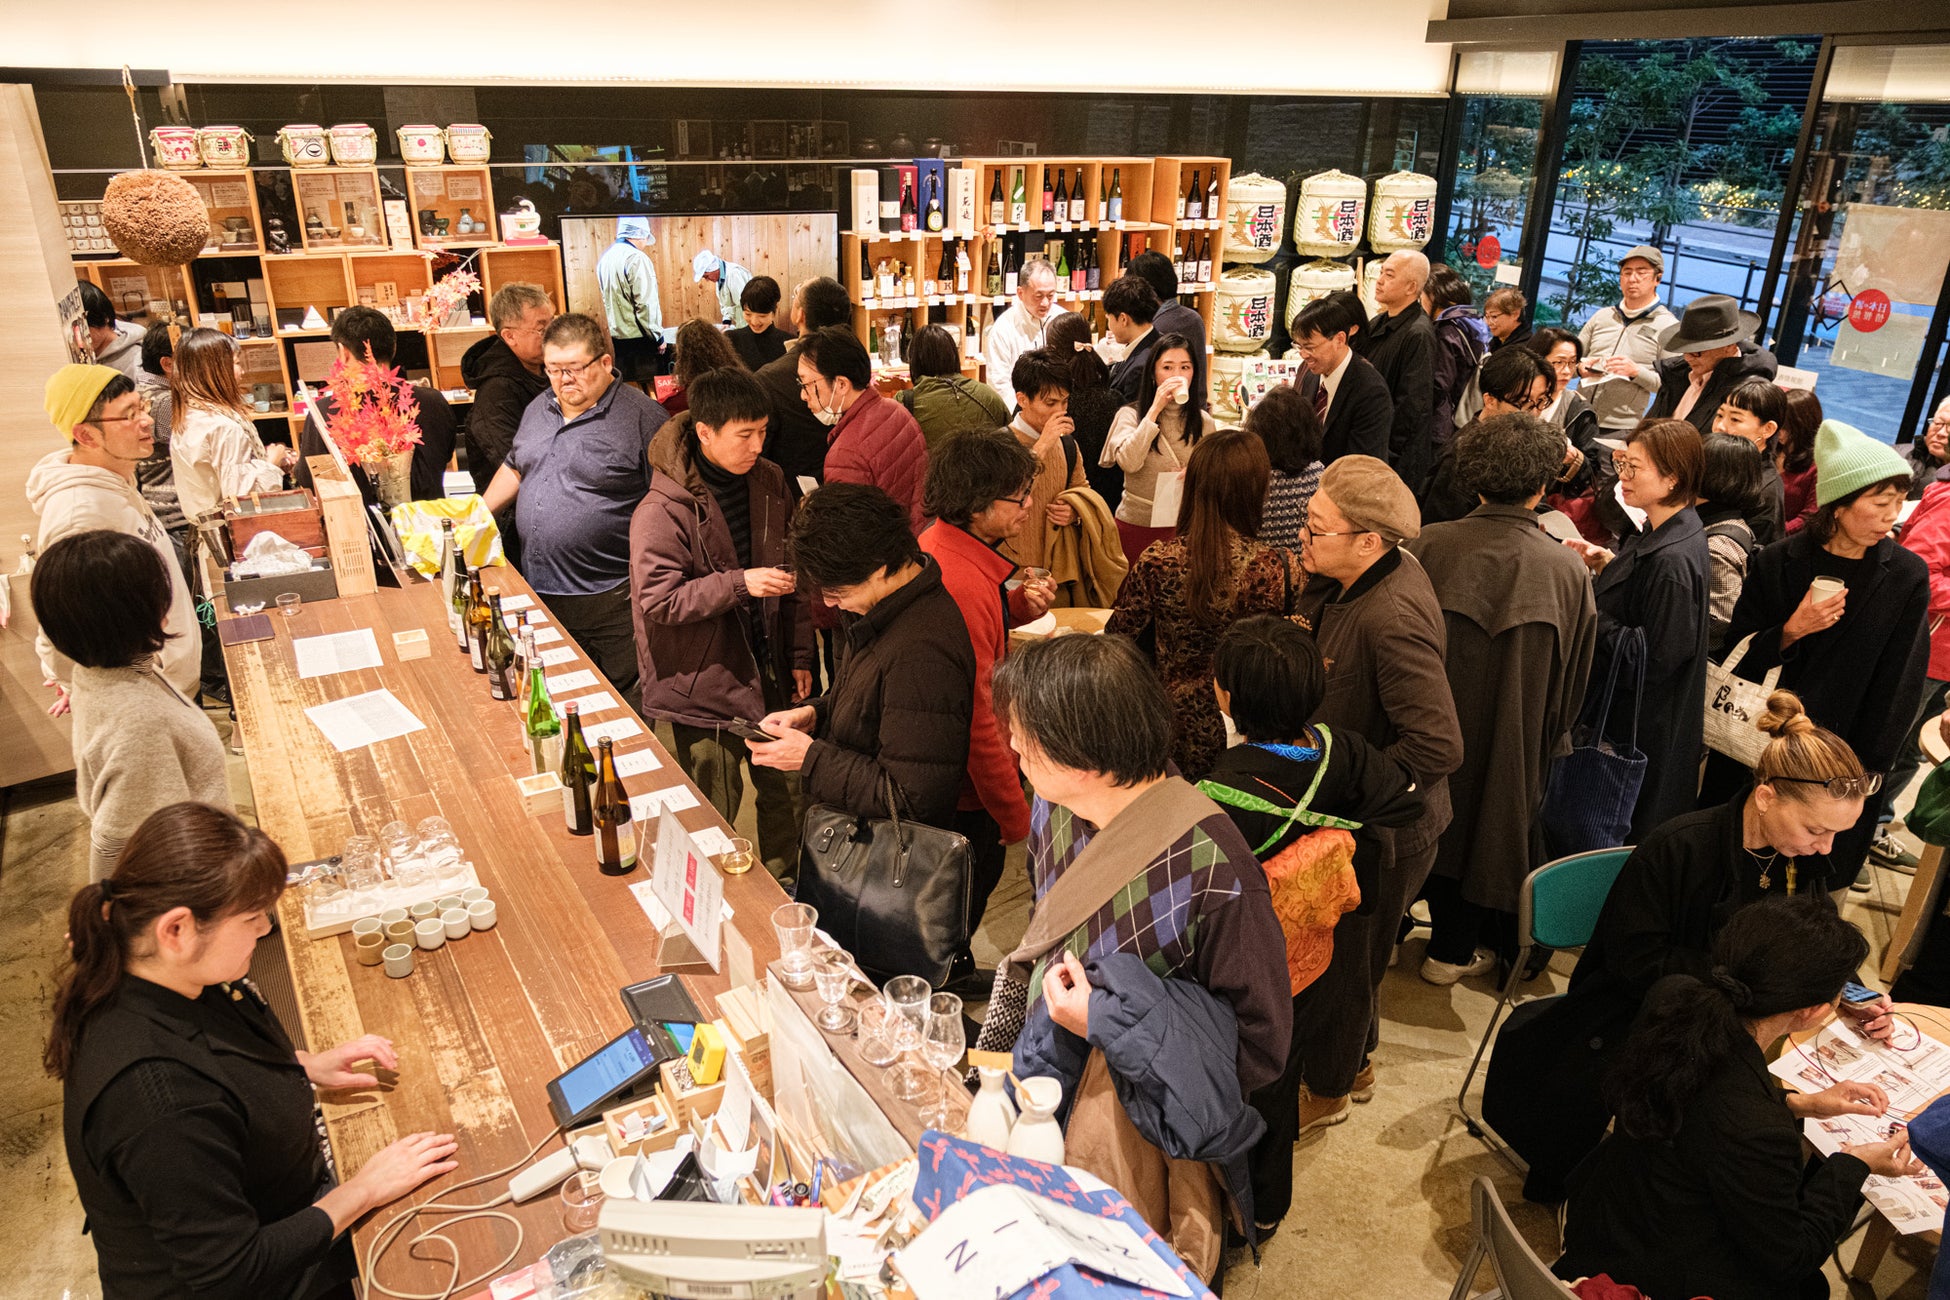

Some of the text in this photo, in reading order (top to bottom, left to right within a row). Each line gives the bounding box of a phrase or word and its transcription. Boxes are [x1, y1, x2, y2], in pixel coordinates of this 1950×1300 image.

[1254, 205, 1275, 247] 日本酒
[1337, 200, 1357, 241] 日本酒
[1411, 199, 1429, 240] 日本酒
[1248, 296, 1267, 337] 日本酒
